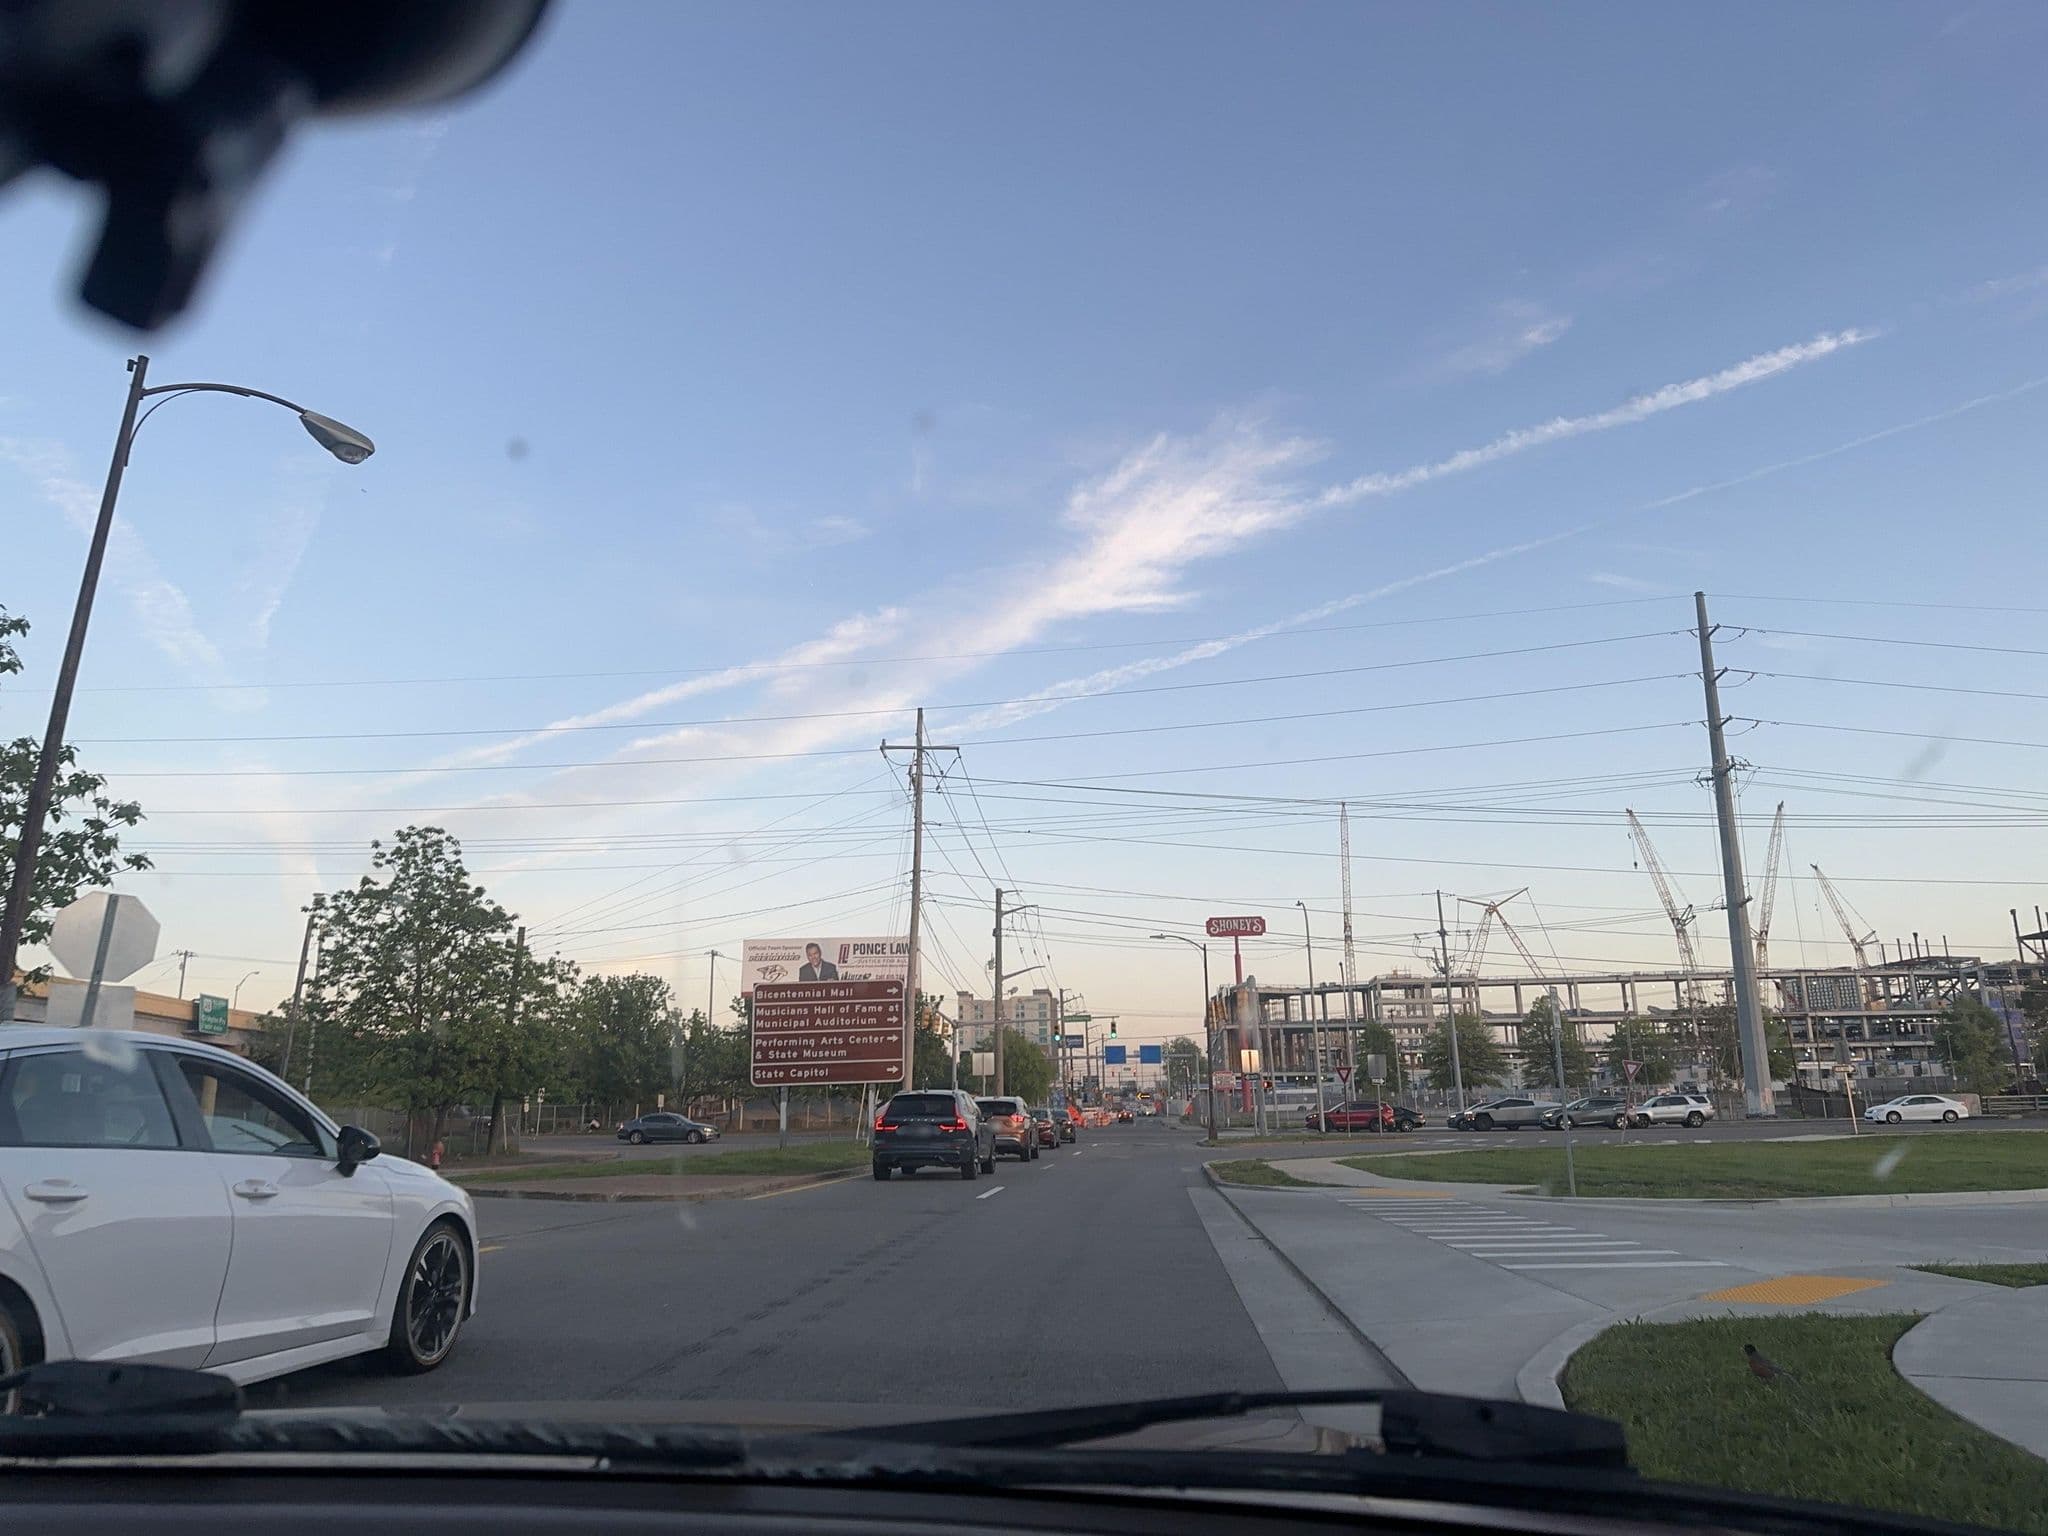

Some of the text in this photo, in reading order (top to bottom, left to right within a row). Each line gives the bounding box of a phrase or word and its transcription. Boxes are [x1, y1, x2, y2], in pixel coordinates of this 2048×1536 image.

[1210, 918, 1262, 934] SHONEY'S
[852, 942, 910, 955] PONCE LAW
[756, 988, 854, 999] Bicentennial Mall
[756, 1004, 899, 1016] Musicians Hall of Fame at
[756, 1016, 877, 1029] Municipal Auditorium
[755, 1035, 885, 1049] Performing Arts Center
[755, 1049, 847, 1059] & State Museum
[755, 1067, 829, 1079] State Capitol
